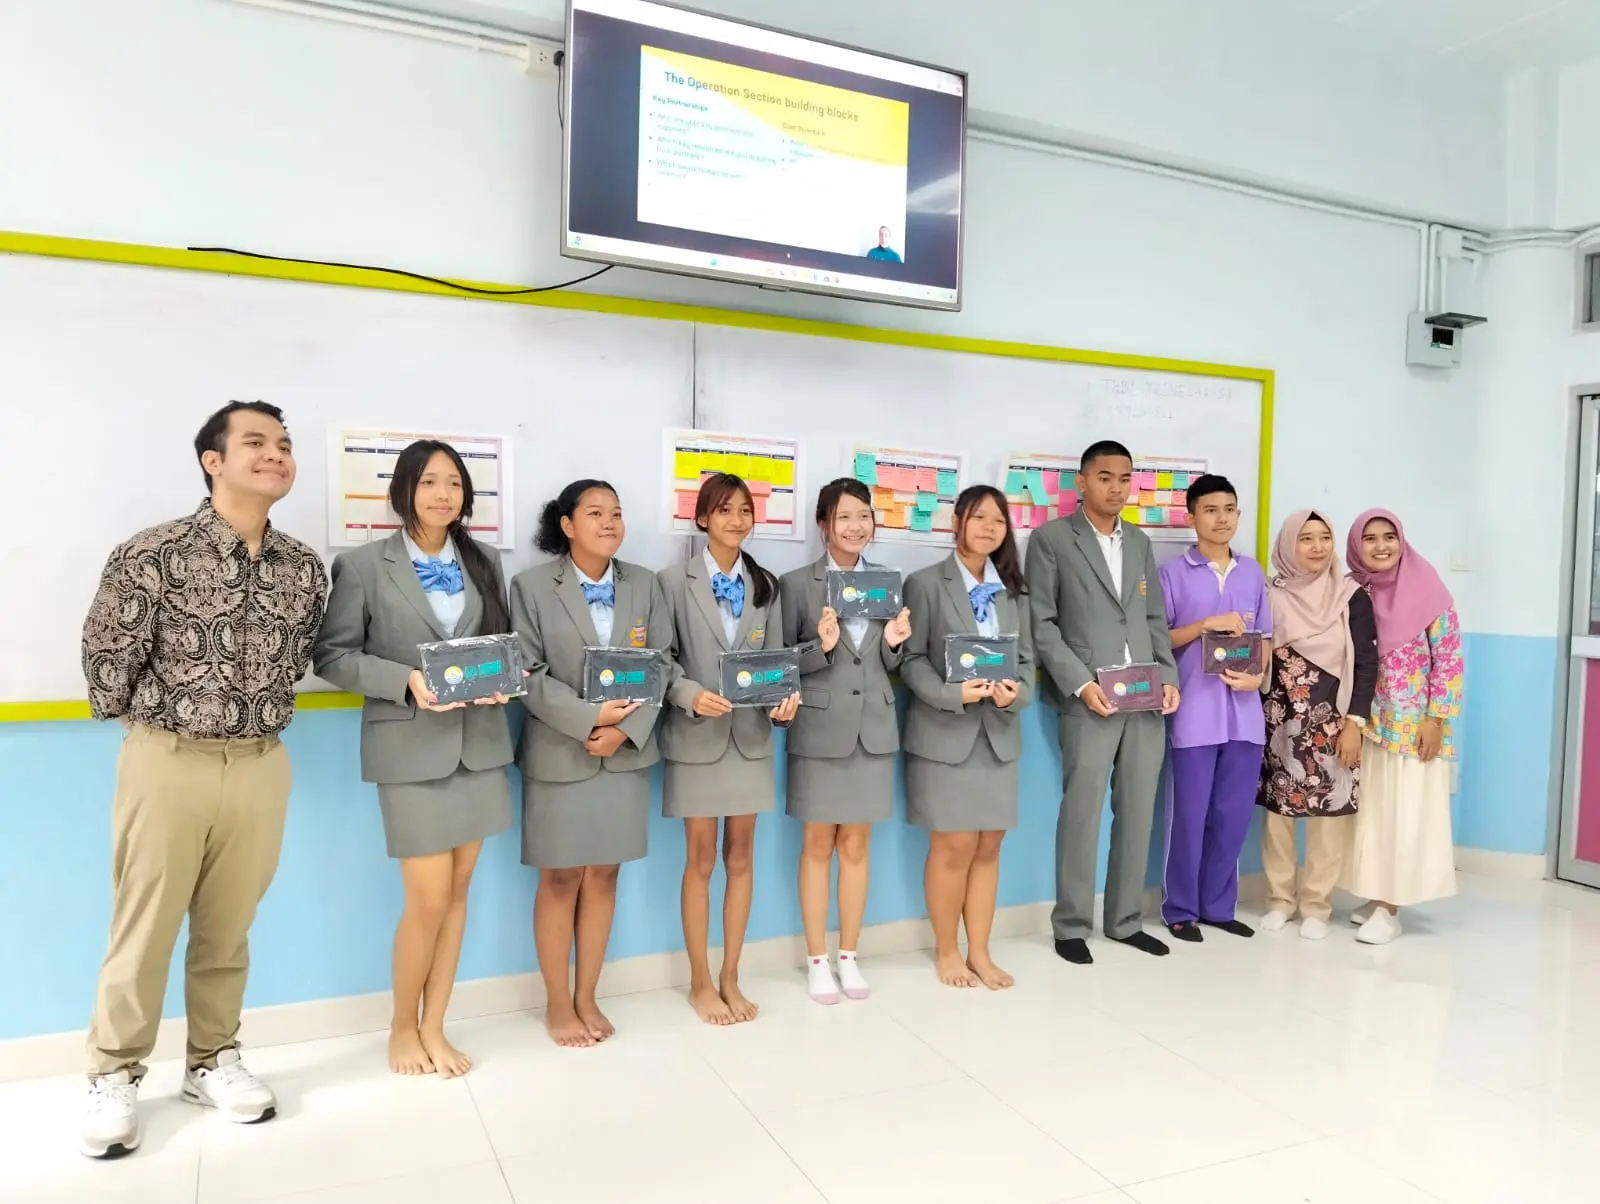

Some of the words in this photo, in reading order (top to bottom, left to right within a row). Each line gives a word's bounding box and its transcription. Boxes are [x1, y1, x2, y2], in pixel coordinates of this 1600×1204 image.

[652, 95, 666, 104] Key
[667, 97, 708, 112] Partnerships
[664, 71, 684, 85] The
[687, 77, 740, 97] Operation
[743, 88, 782, 105] Section
[784, 97, 824, 117] building
[826, 106, 858, 122] blocks
